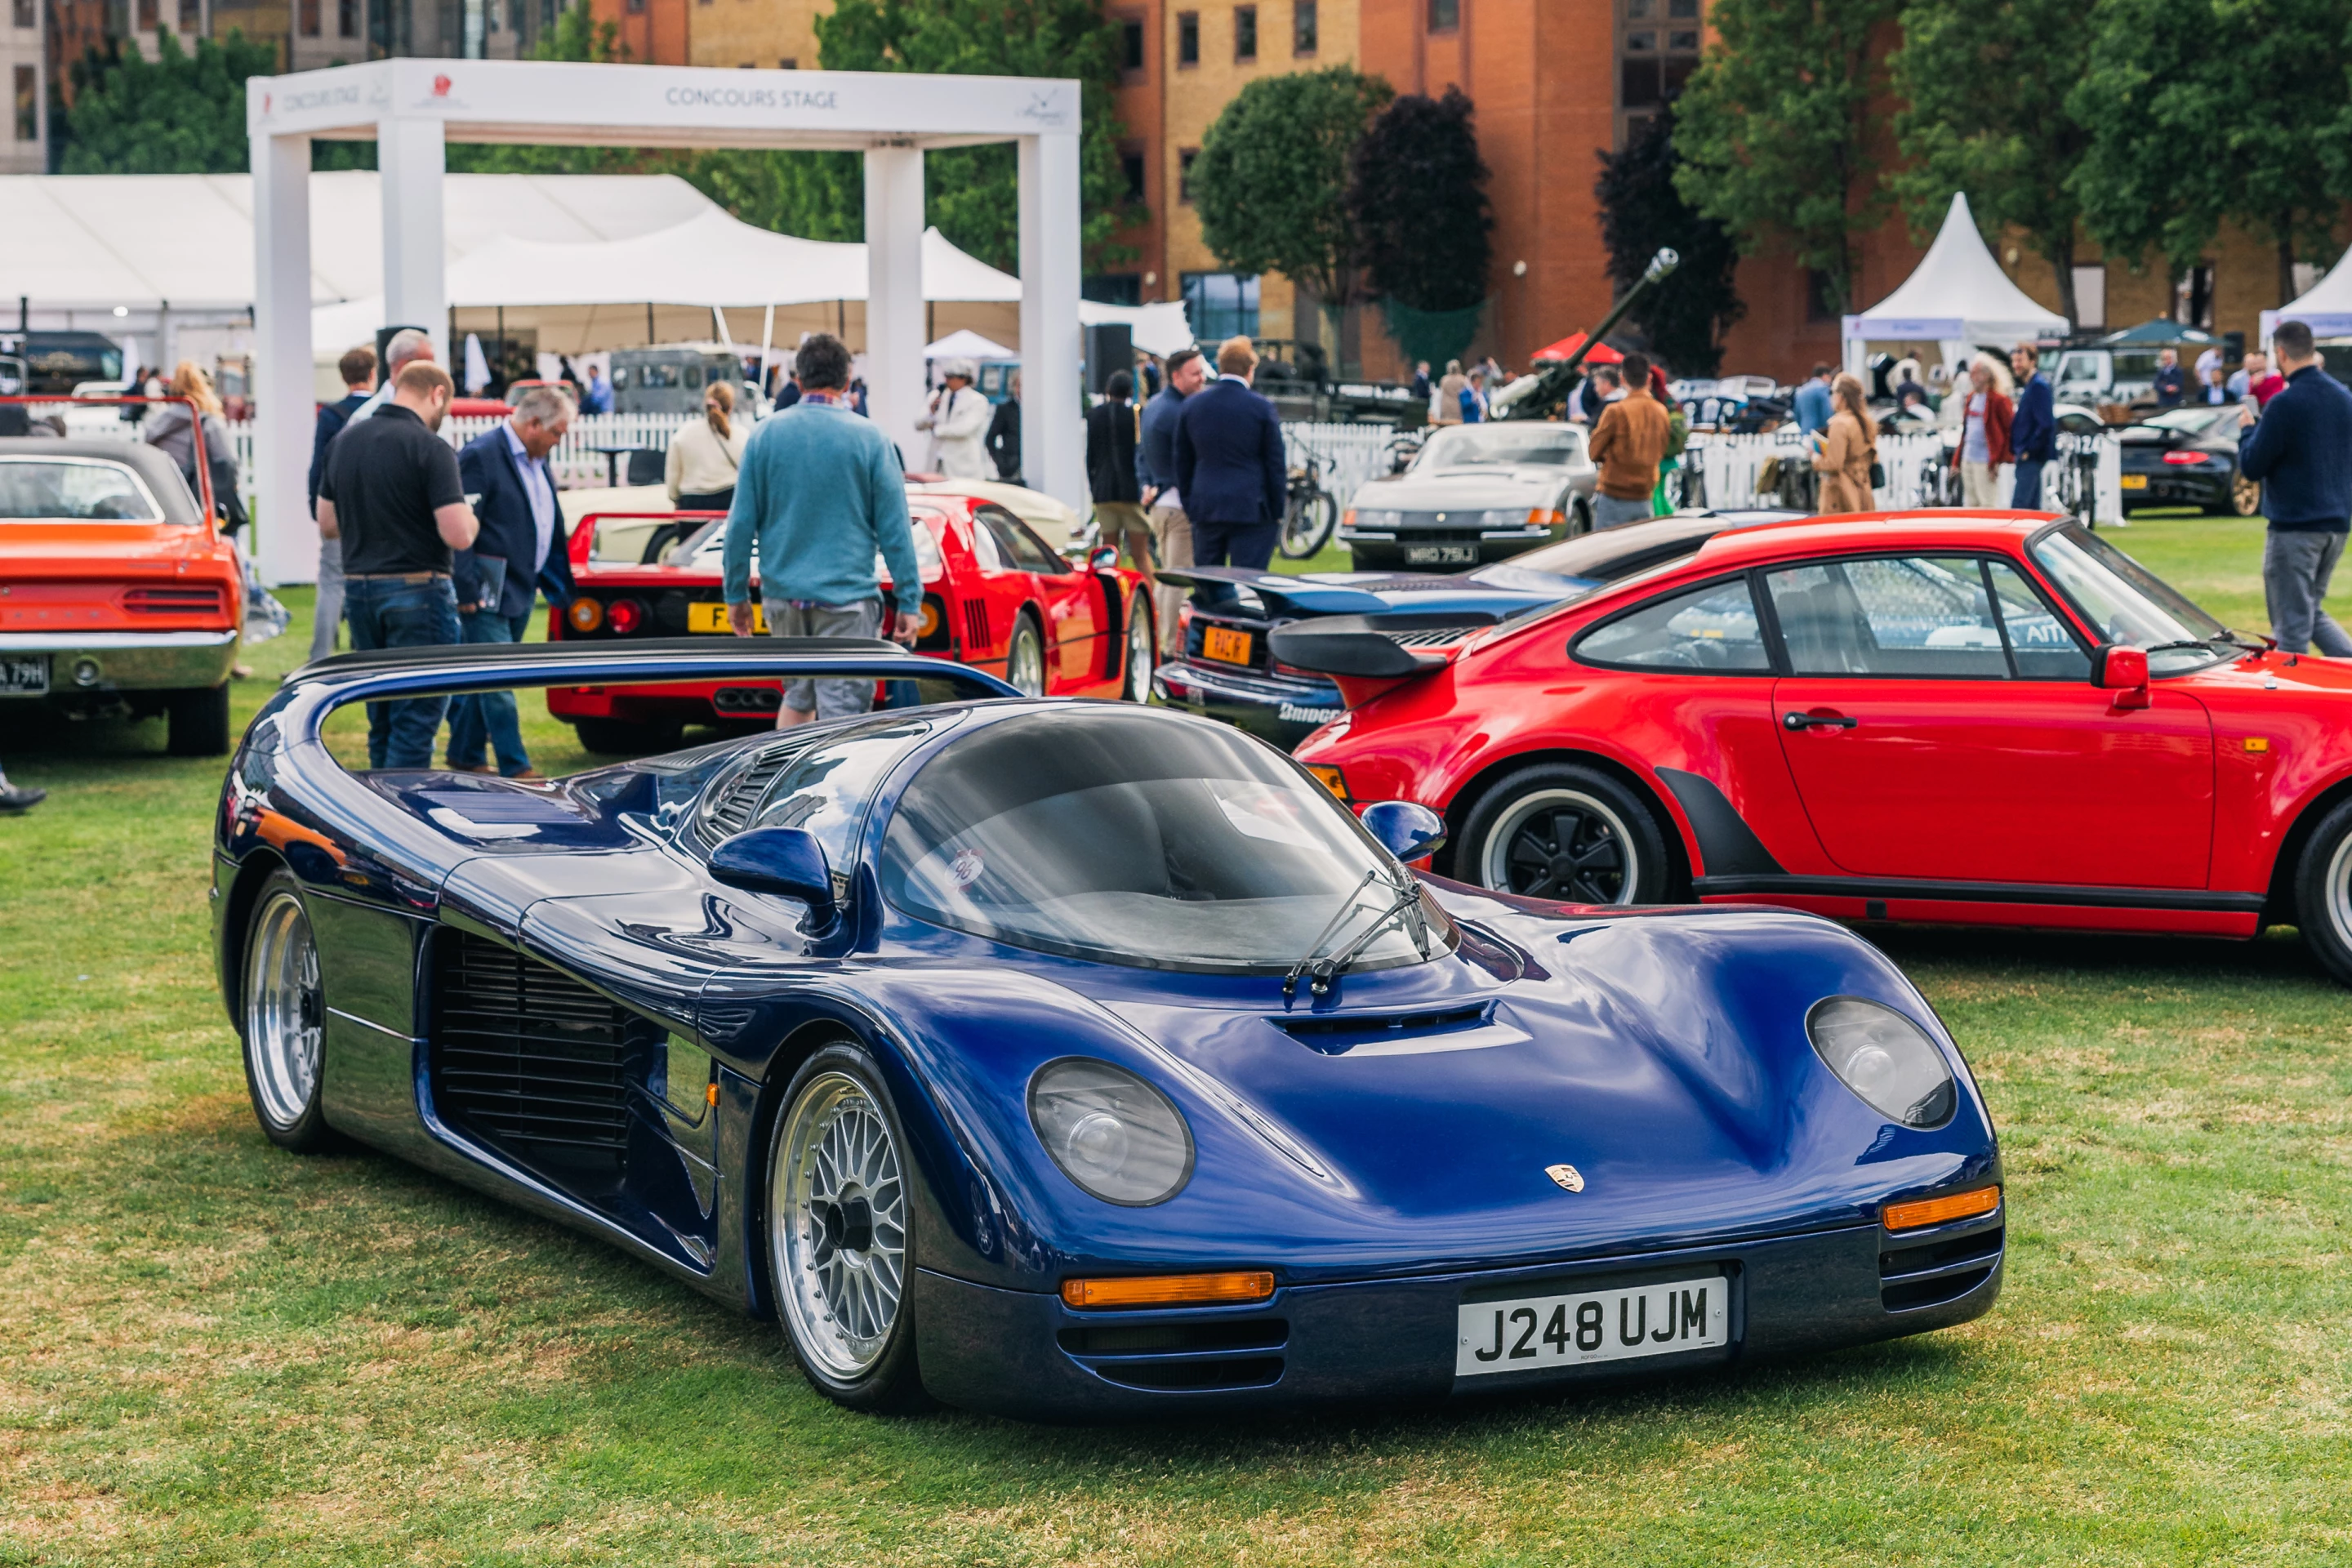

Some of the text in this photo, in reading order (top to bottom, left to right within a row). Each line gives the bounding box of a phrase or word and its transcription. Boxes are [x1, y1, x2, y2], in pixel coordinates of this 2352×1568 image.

[665, 87, 838, 109] CONCOURS STAGE
[11, 663, 44, 684] 79H
[953, 861, 975, 881] 96
[1475, 1287, 1708, 1362] J248 UJM
